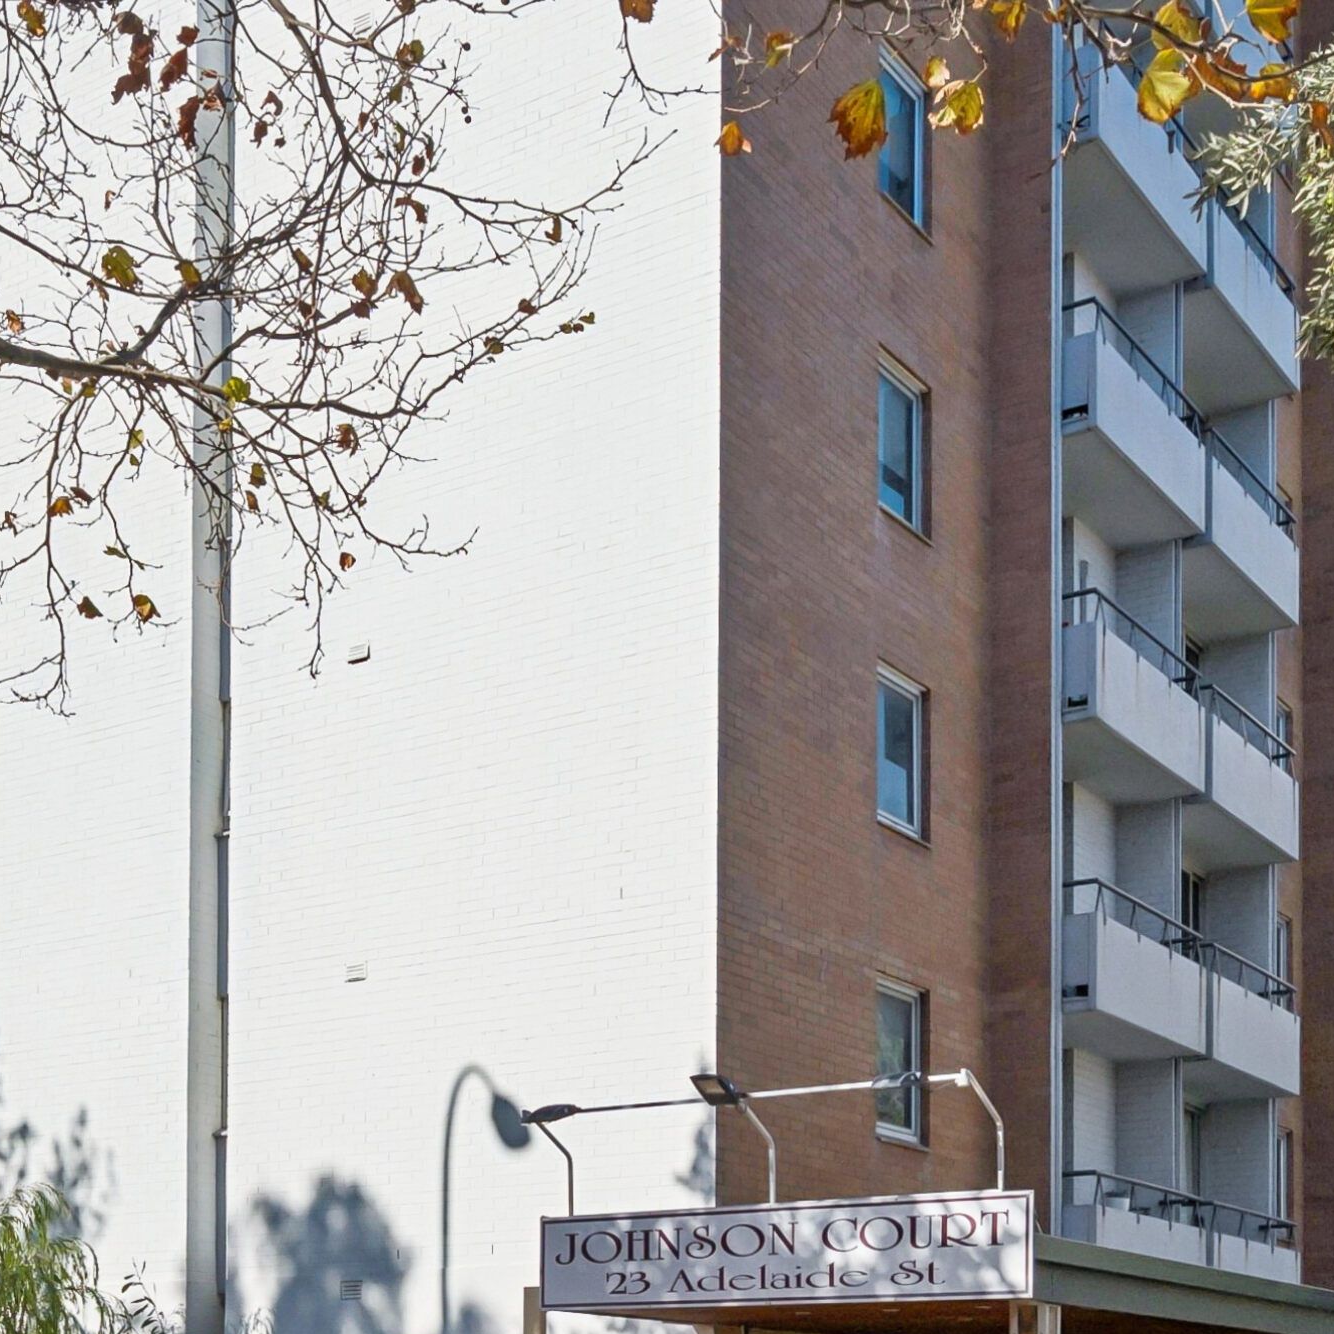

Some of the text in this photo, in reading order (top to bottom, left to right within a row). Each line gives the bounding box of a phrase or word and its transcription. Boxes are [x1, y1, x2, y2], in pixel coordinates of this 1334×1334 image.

[555, 1209, 1010, 1265] JOHNSON COURT
[605, 1260, 946, 1295] 23 Adelaide St
